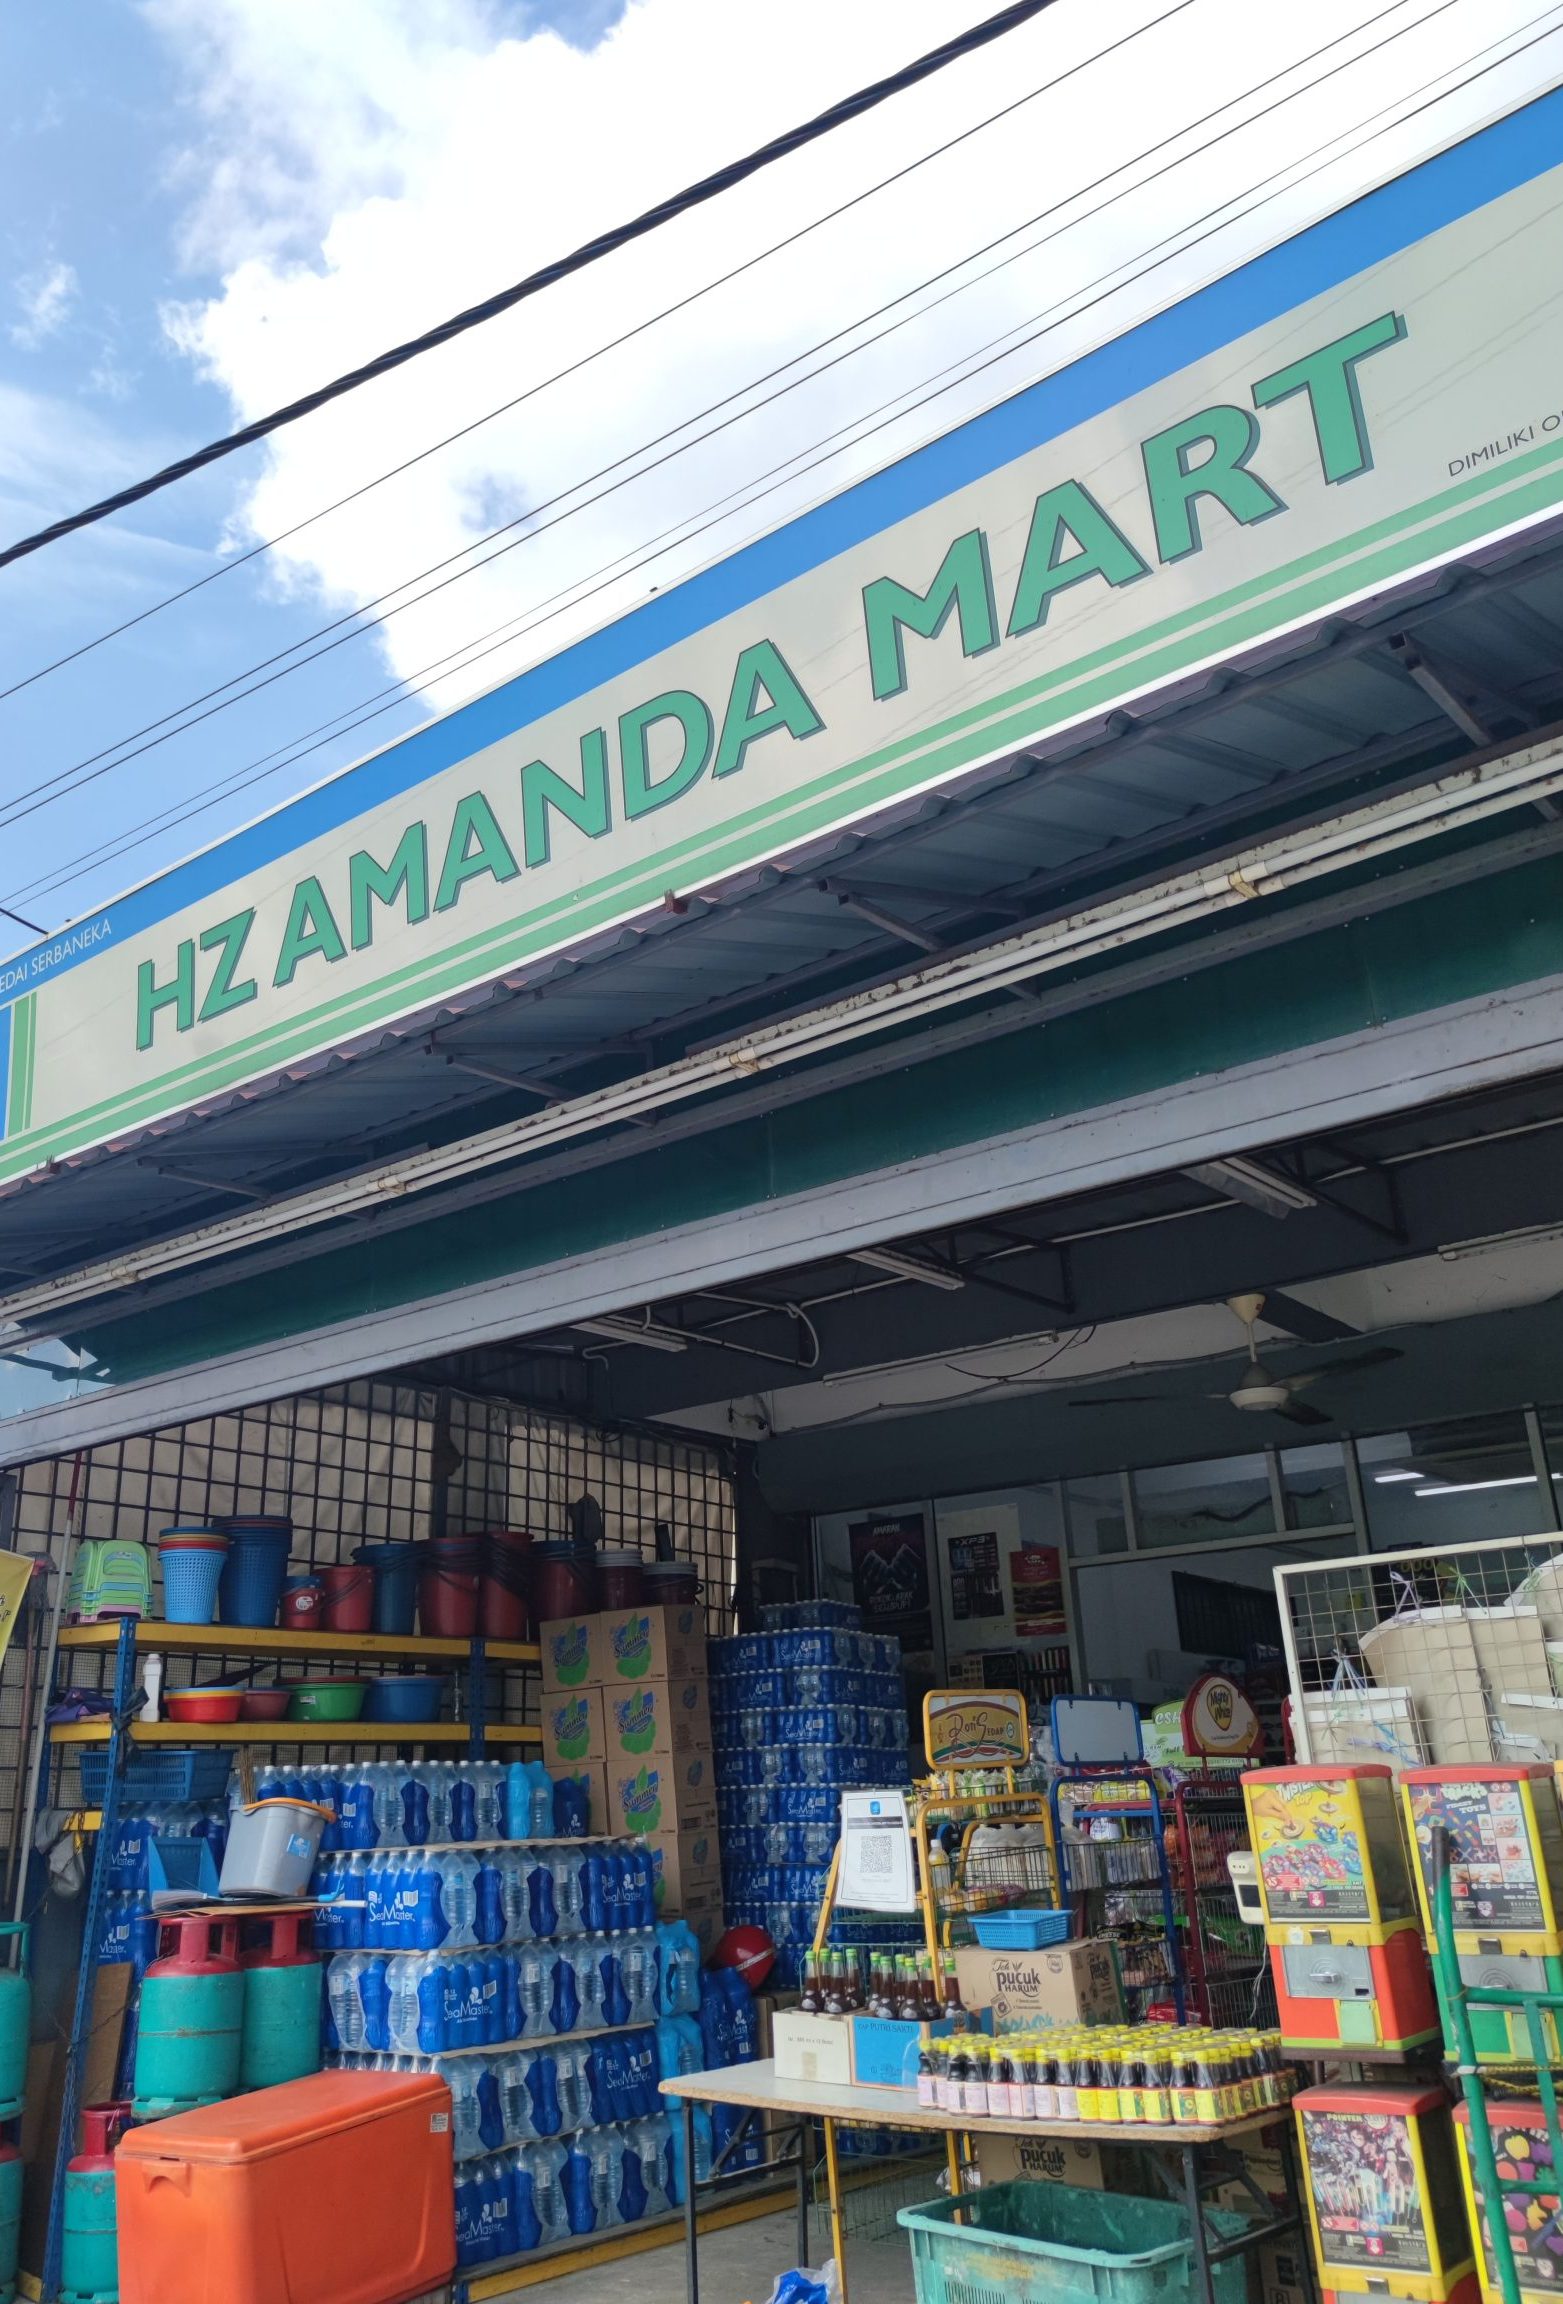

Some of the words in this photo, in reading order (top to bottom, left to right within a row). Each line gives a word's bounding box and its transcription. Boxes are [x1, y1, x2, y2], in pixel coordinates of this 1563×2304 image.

[1448, 425, 1534, 477] DIMILIKI
[861, 309, 1408, 702] MART
[31, 919, 112, 976] SERBANEKA
[369, 1902, 416, 1922] SeaMaster
[996, 1968, 1041, 1992] pucuk
[1004, 1984, 1040, 1997] HARUM
[1019, 2146, 1066, 2170] pucuk
